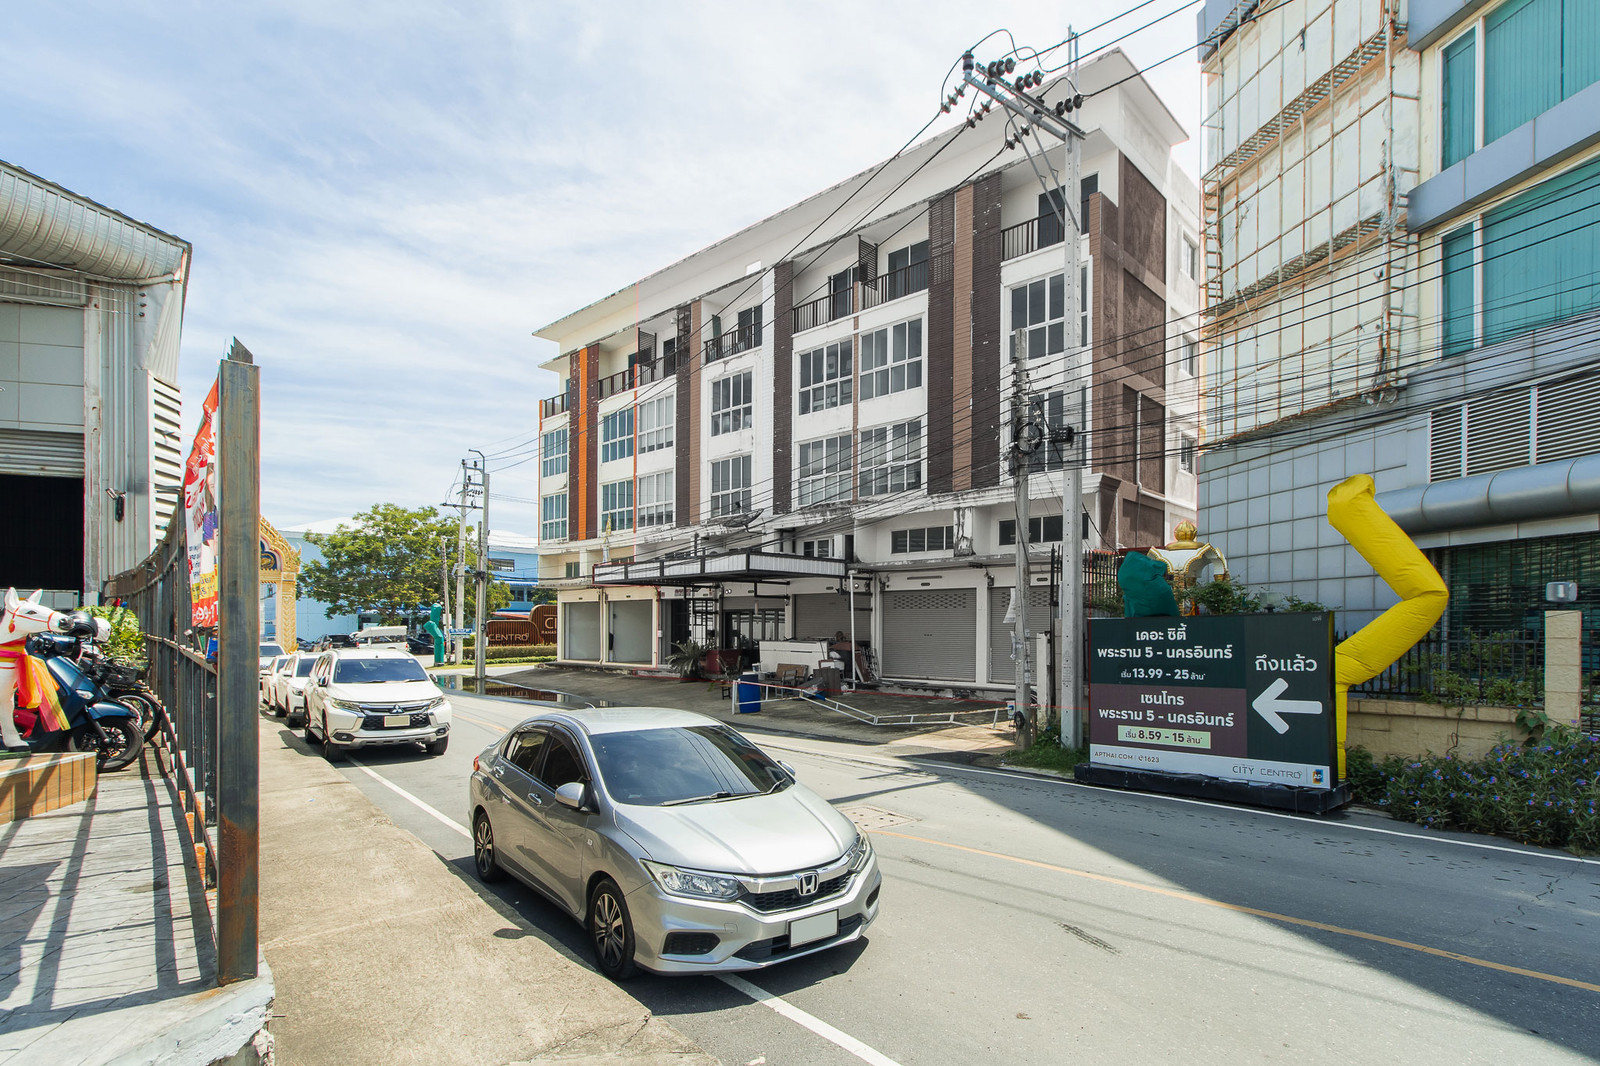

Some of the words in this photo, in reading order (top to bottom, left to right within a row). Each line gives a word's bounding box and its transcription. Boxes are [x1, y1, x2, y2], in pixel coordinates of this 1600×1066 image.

[544, 617, 557, 630] CI
[488, 633, 529, 642] CENTRO
[1136, 631, 1164, 641] เดอะ
[1168, 623, 1187, 641] ซิตี้
[1098, 648, 1141, 658] พระราม
[1145, 646, 1153, 658] 5
[1166, 644, 1232, 659] นครอินทร์
[1254, 654, 1318, 672] ถึงแล้ว
[1132, 668, 1162, 678] 13.99
[1174, 670, 1190, 680] 25
[1140, 690, 1184, 706] เซนโทร
[1099, 708, 1142, 720] พระราม
[1146, 710, 1154, 721] 5
[1168, 712, 1234, 727] นครอินทร์
[1138, 730, 1162, 740] 8.59
[1172, 732, 1184, 742] 15
[1094, 751, 1133, 760] APTHAI.COM
[1232, 766, 1254, 774] CITY
[1260, 768, 1302, 779] CENTRO
